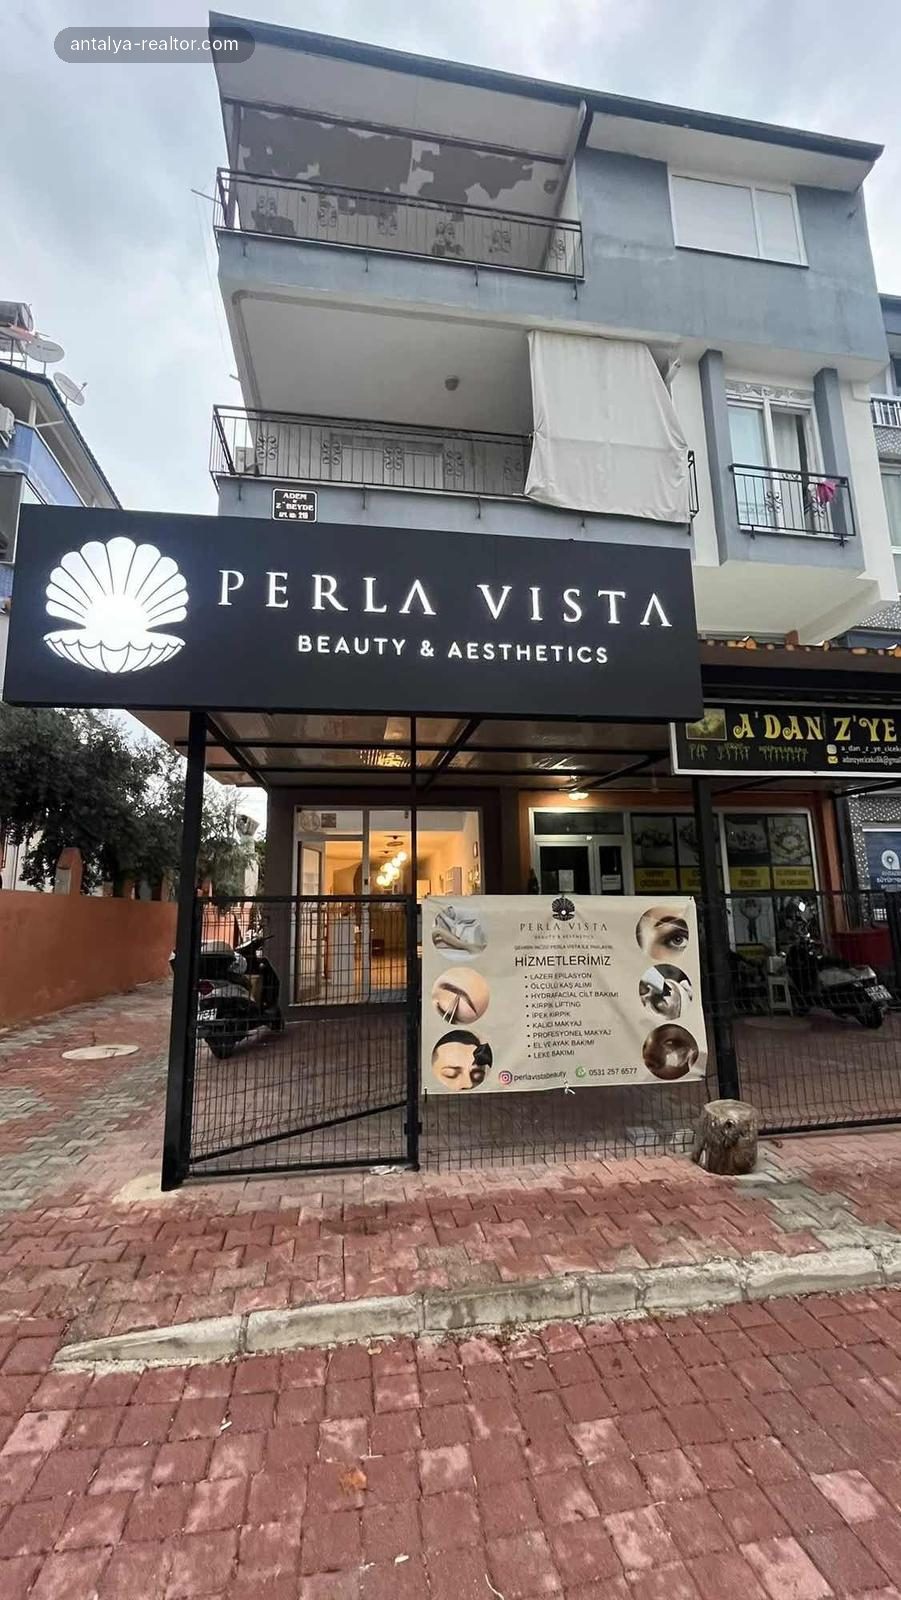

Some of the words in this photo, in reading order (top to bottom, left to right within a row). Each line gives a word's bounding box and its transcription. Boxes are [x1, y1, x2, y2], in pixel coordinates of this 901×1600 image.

[276, 502, 314, 511] ZBEYDE
[218, 569, 437, 616] PERLA
[476, 584, 673, 627] VISTA
[298, 635, 406, 656] BEAUTY
[420, 639, 434, 657] &
[447, 641, 609, 664] AESTHETICS
[732, 711, 824, 741] A'DAN
[832, 714, 898, 742] Z'YE
[520, 922, 560, 931] PERLA
[568, 922, 607, 931] VISTA
